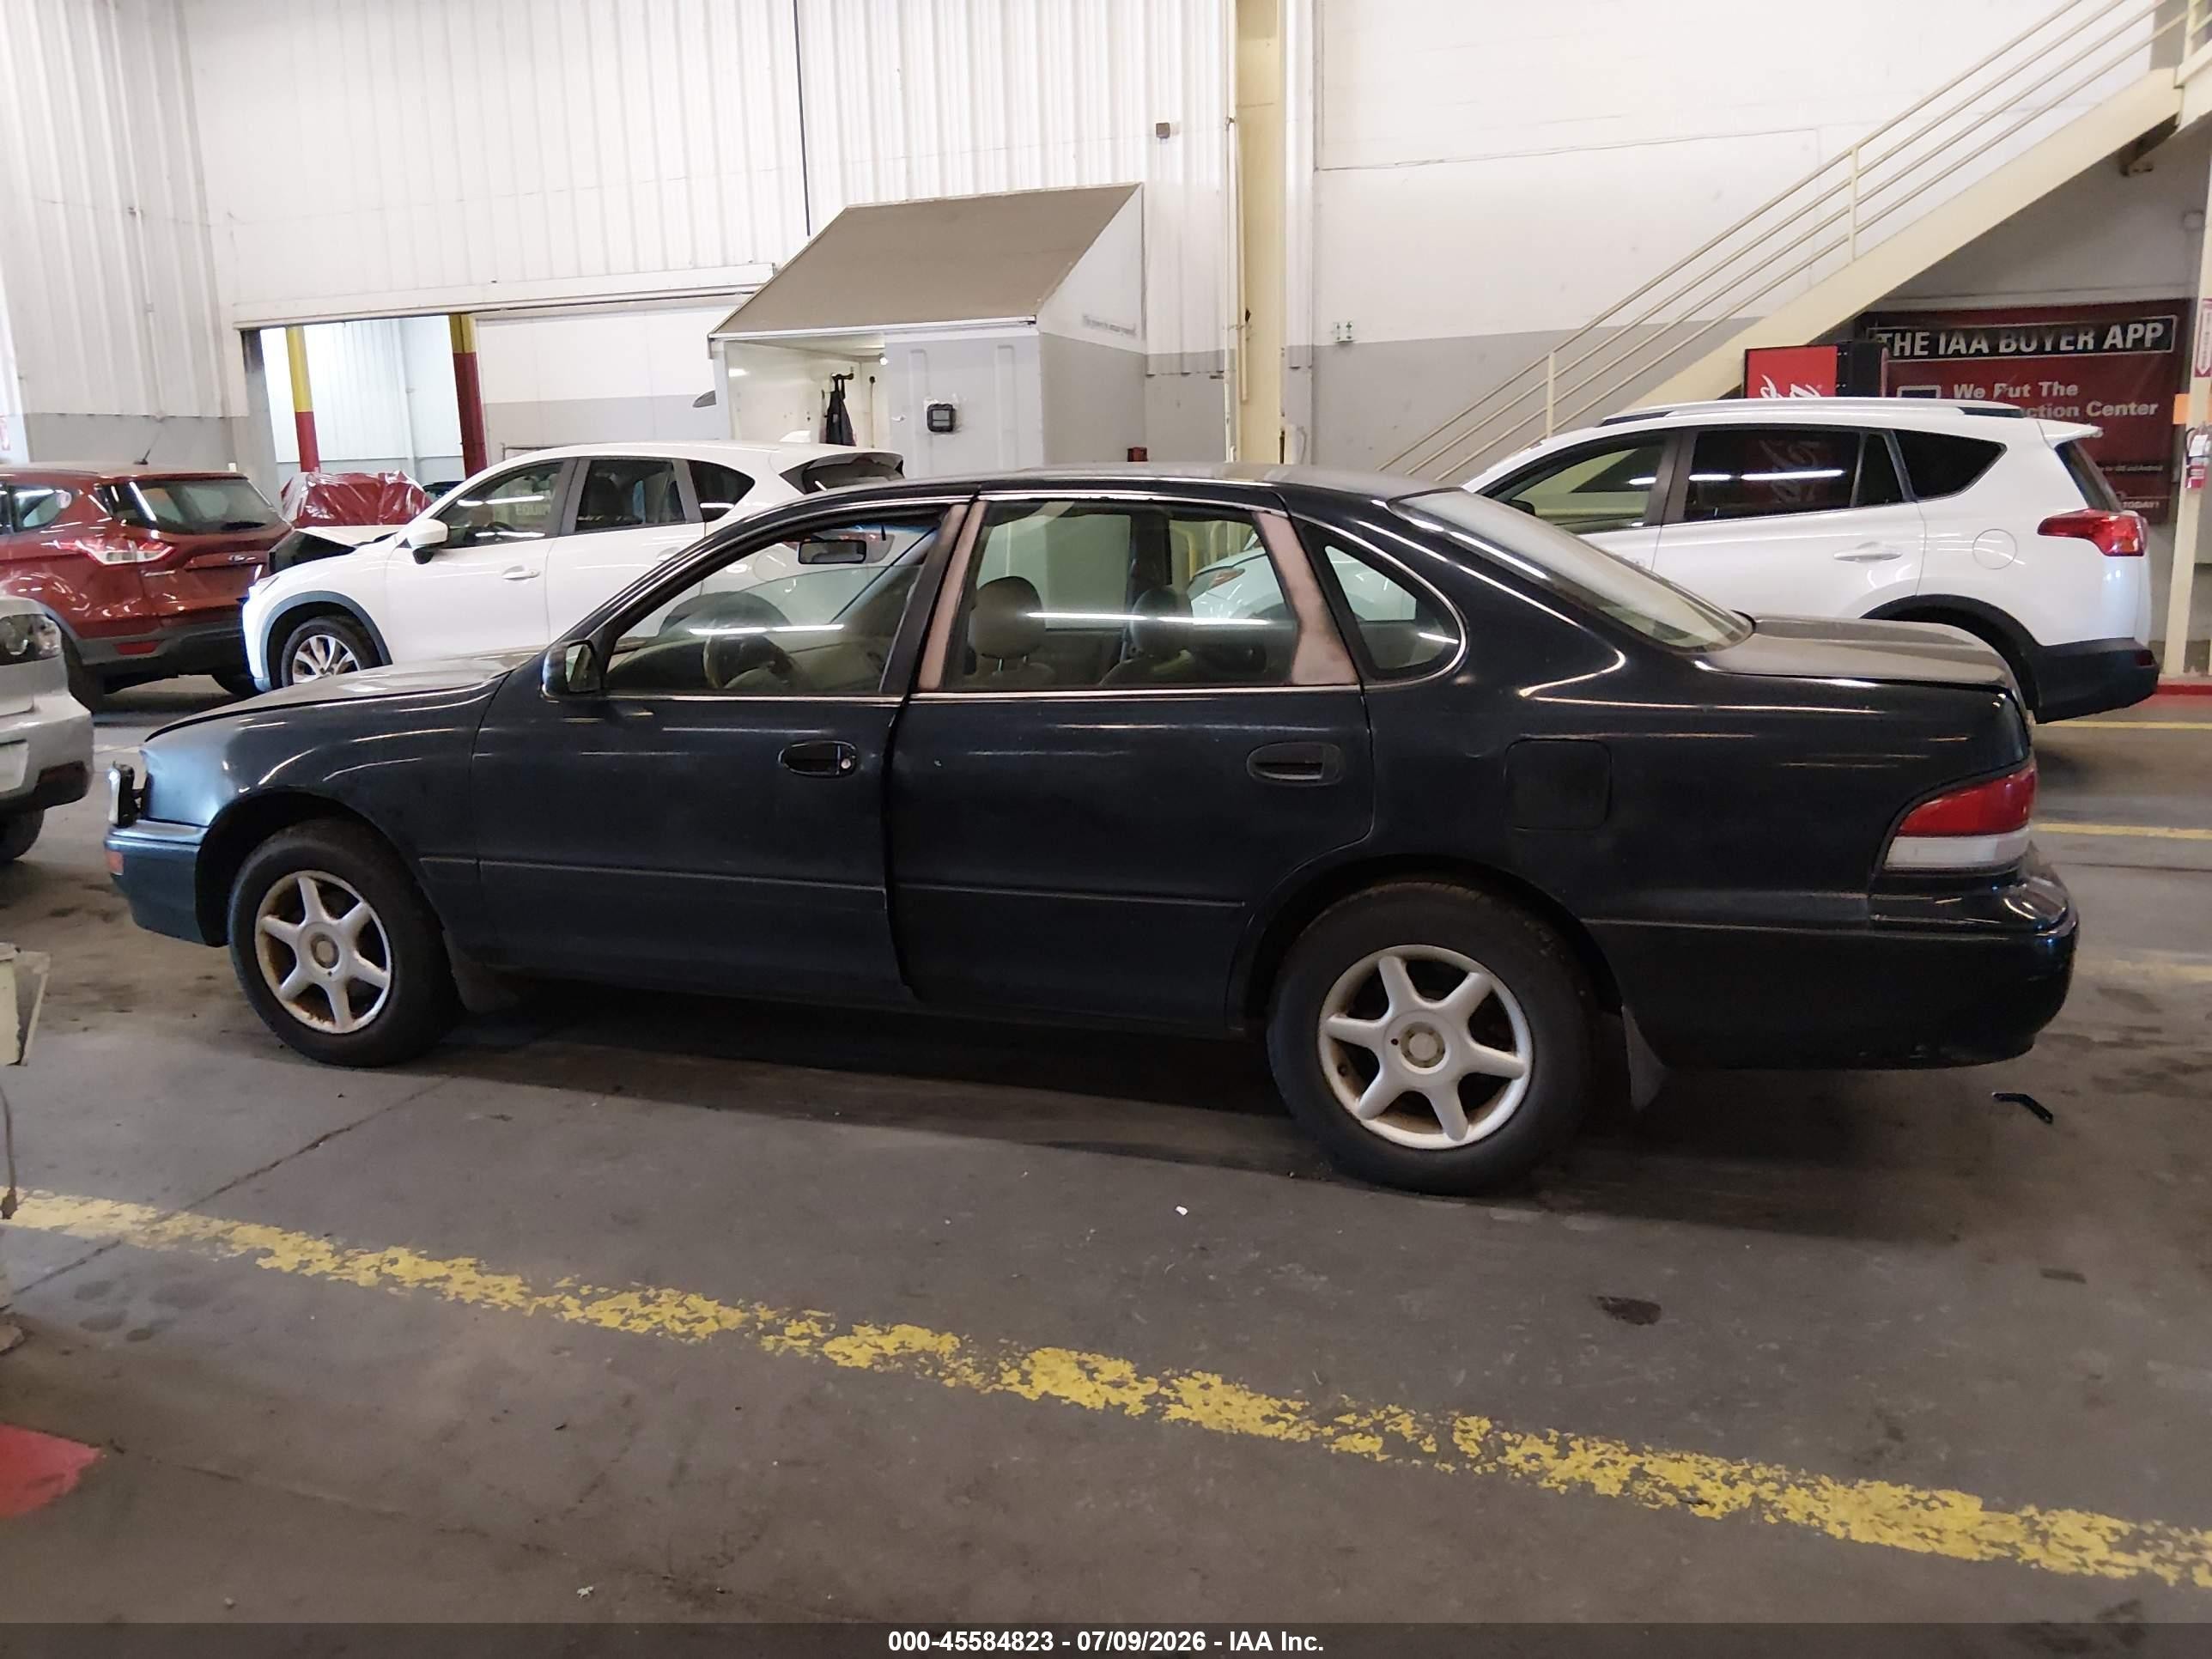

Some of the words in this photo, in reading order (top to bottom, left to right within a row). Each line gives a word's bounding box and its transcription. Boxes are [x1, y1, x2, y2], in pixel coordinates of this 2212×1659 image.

[1876, 331, 1930, 356] THE
[1938, 330, 1990, 355] IAA
[1998, 328, 2095, 354] BUYER
[2102, 322, 2164, 349] APP
[1954, 383, 1986, 399] We
[1992, 383, 2032, 399] Put
[2038, 380, 2079, 398] The
[2020, 403, 2080, 419] ction
[2086, 399, 2159, 417] Center
